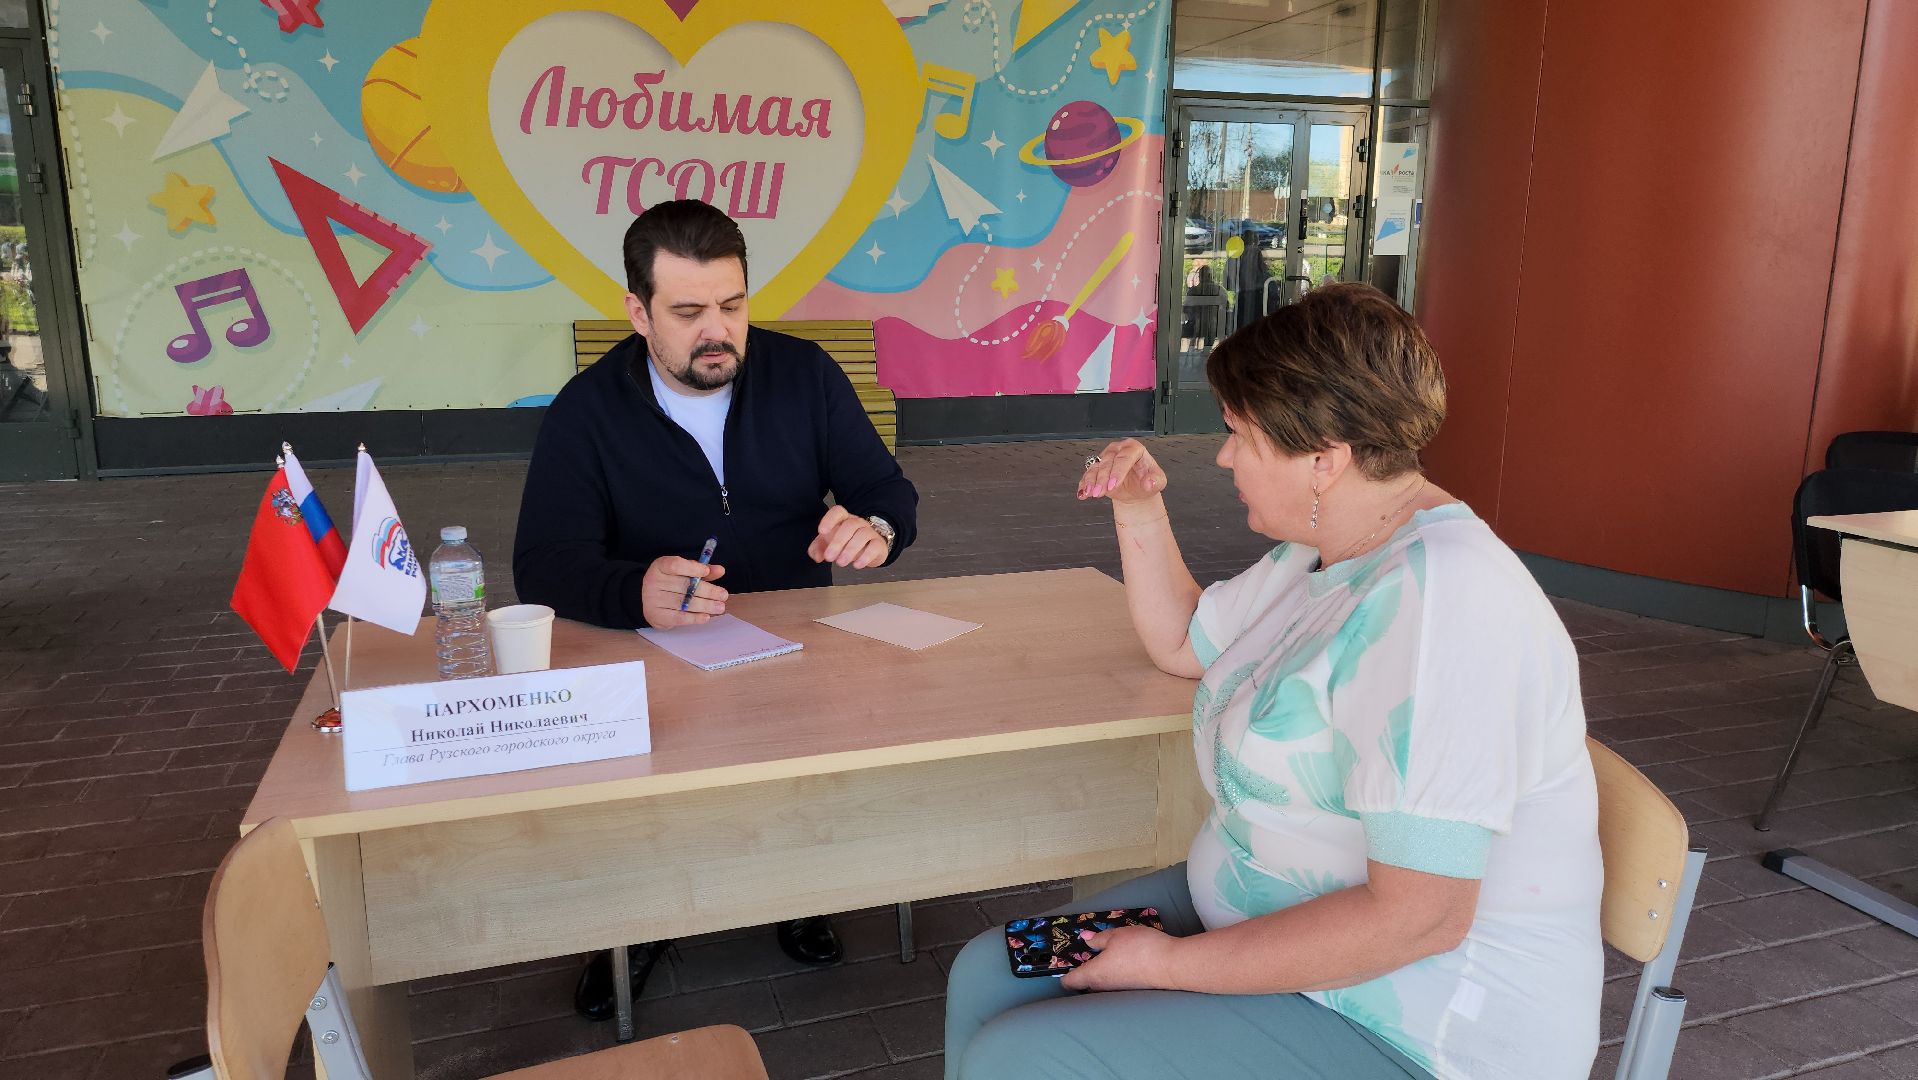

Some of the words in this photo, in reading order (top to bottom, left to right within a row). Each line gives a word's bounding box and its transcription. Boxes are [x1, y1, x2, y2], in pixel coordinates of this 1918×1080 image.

[519, 65, 832, 139] Любимая
[581, 155, 786, 219] ТСОШ
[425, 688, 573, 718] ПАРХОМЕНКО
[411, 720, 485, 743] Николай
[491, 713, 589, 734] Николаевич
[382, 750, 424, 767] Глава
[430, 744, 491, 764] Рузского
[494, 733, 569, 756] городского
[572, 729, 617, 748] округа
